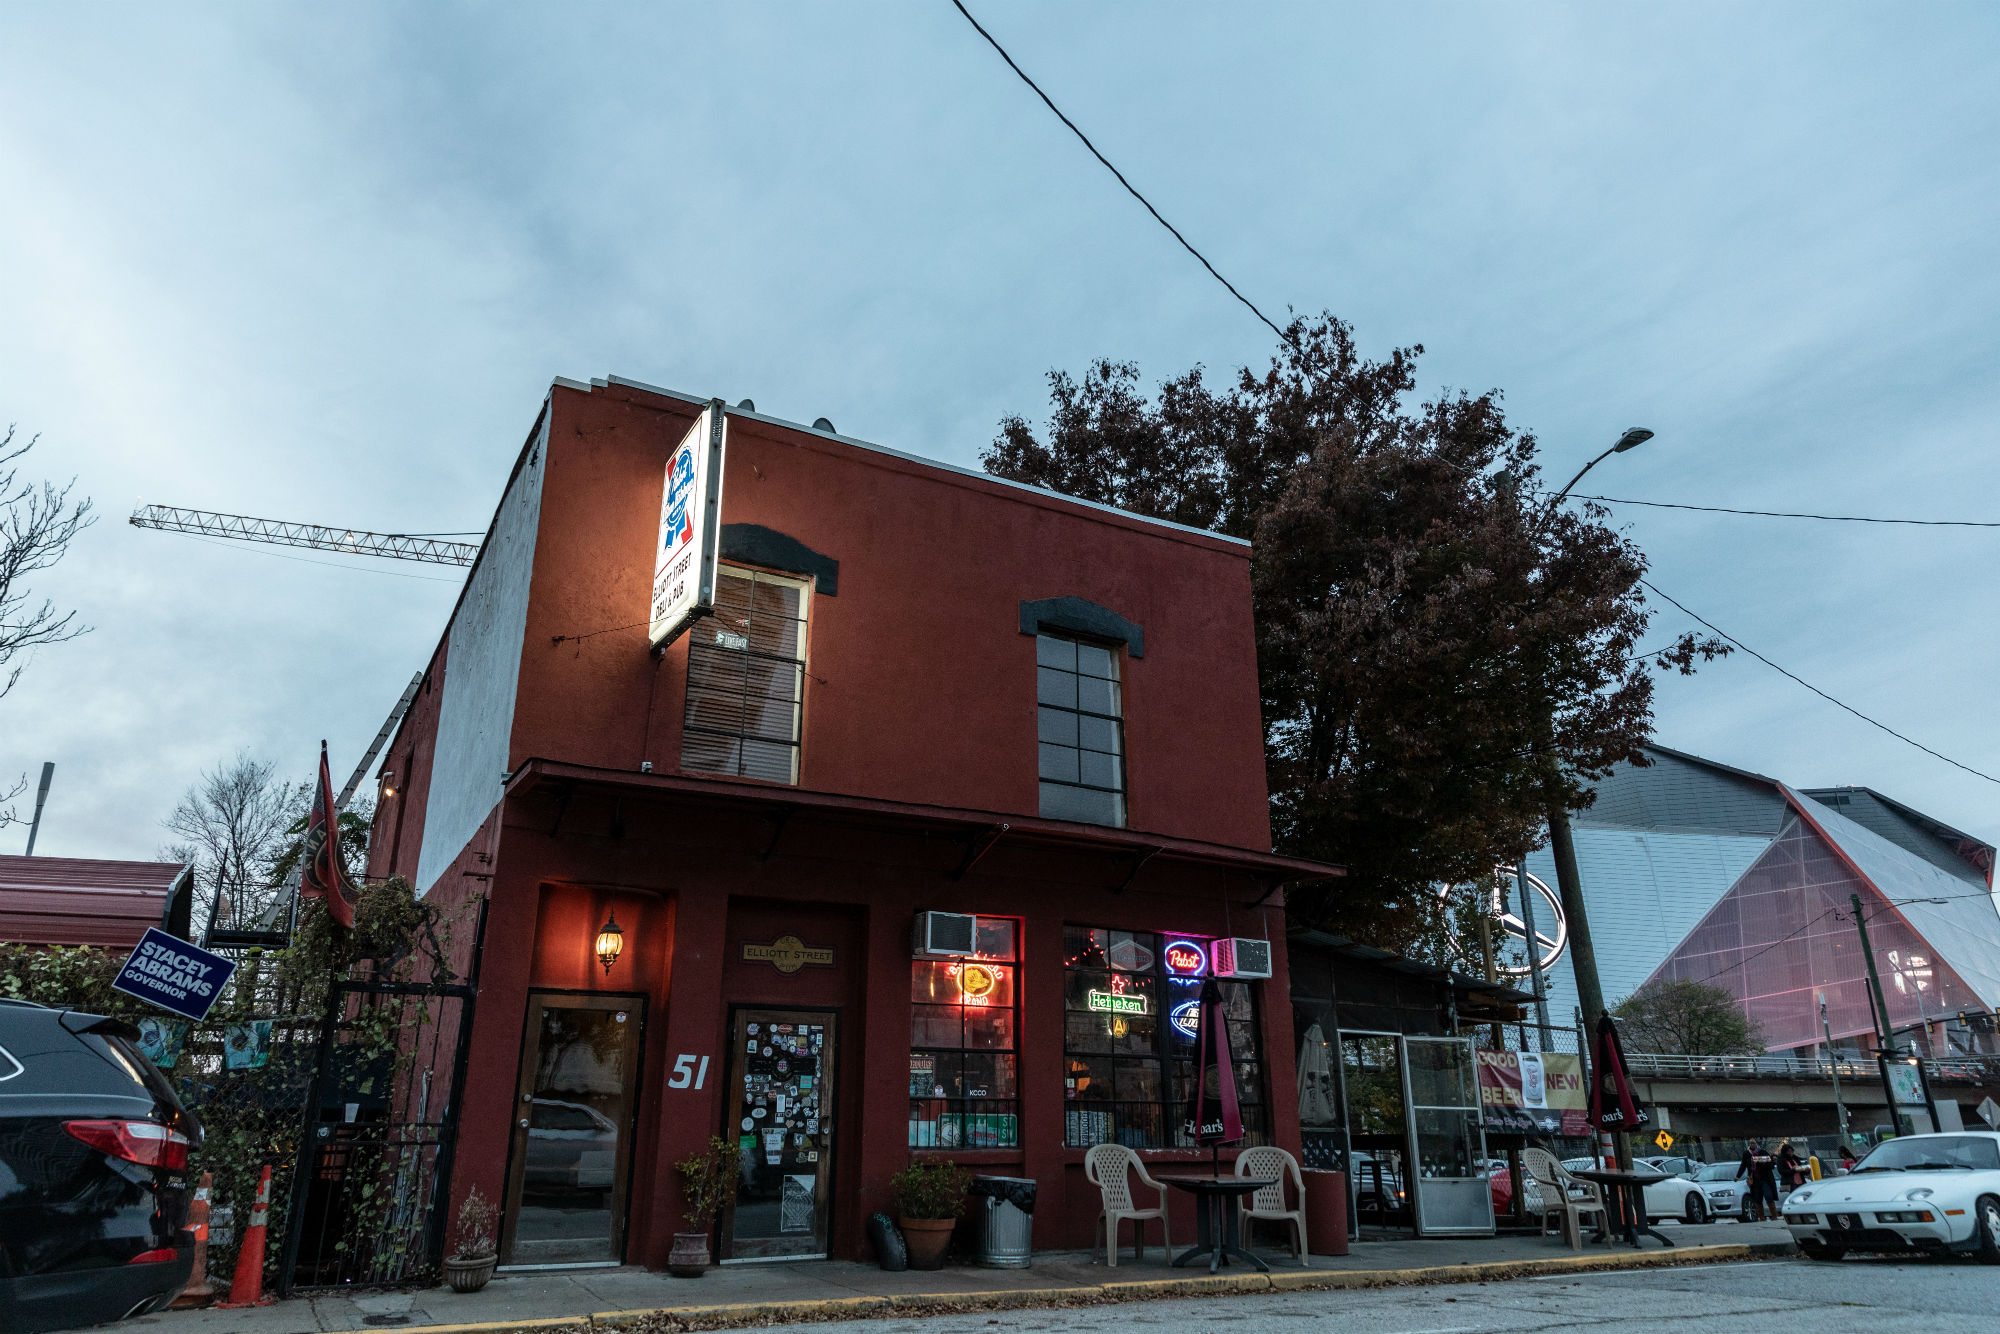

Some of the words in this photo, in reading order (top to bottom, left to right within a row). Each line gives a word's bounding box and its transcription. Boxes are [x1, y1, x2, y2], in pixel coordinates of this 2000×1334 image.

[653, 572, 672, 603] ELLIOTT
[673, 552, 692, 582] STREET
[655, 597, 668, 620] DELI
[673, 580, 684, 603] PUB
[140, 941, 213, 978] STACEY
[747, 948, 789, 958] ELLIOTT
[794, 950, 832, 960] STREET
[1169, 949, 1200, 969] Pabst
[124, 969, 187, 1000] GOVERNOR
[129, 955, 213, 997] ABRAMS
[1092, 994, 1142, 1012] Heineken
[1478, 1051, 1518, 1068] GOOD
[667, 1053, 710, 1090] 51
[1546, 1073, 1580, 1090] NEW
[969, 1089, 987, 1097] KCCO
[1482, 1086, 1524, 1106] BEER
[1601, 1107, 1624, 1123] oar's
[1200, 1118, 1224, 1134] oar's
